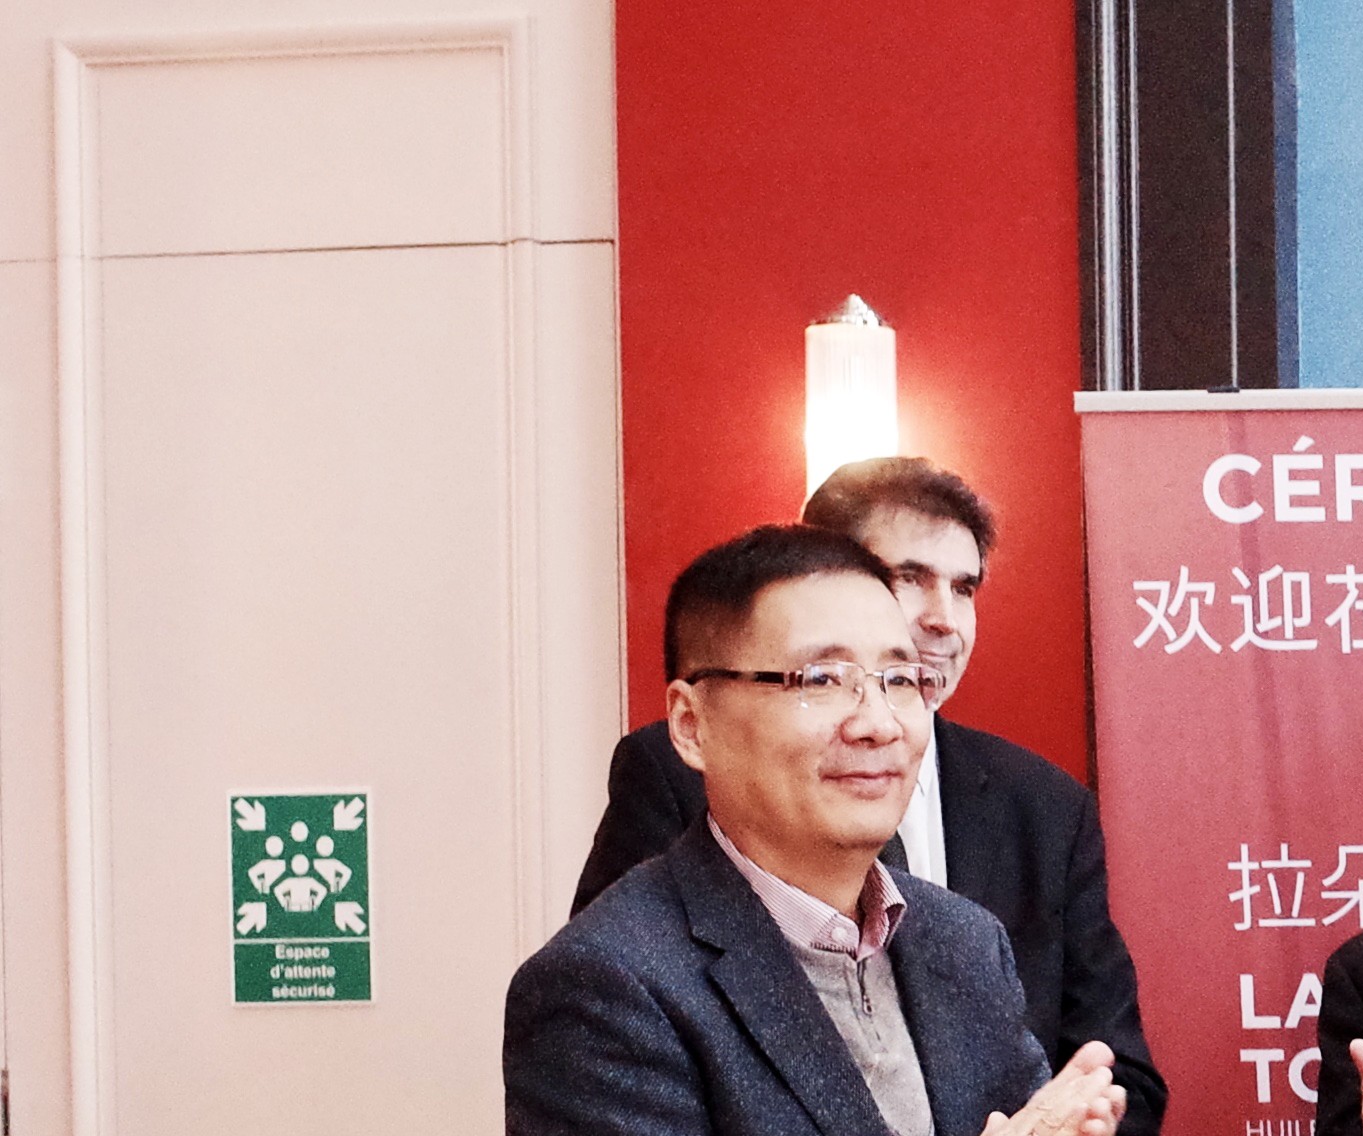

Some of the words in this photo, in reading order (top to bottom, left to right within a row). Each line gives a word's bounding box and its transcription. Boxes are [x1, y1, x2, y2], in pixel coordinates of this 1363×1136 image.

[275, 944, 330, 960] Espace
[270, 964, 336, 979] d'attente
[272, 984, 335, 998] sécurisé
